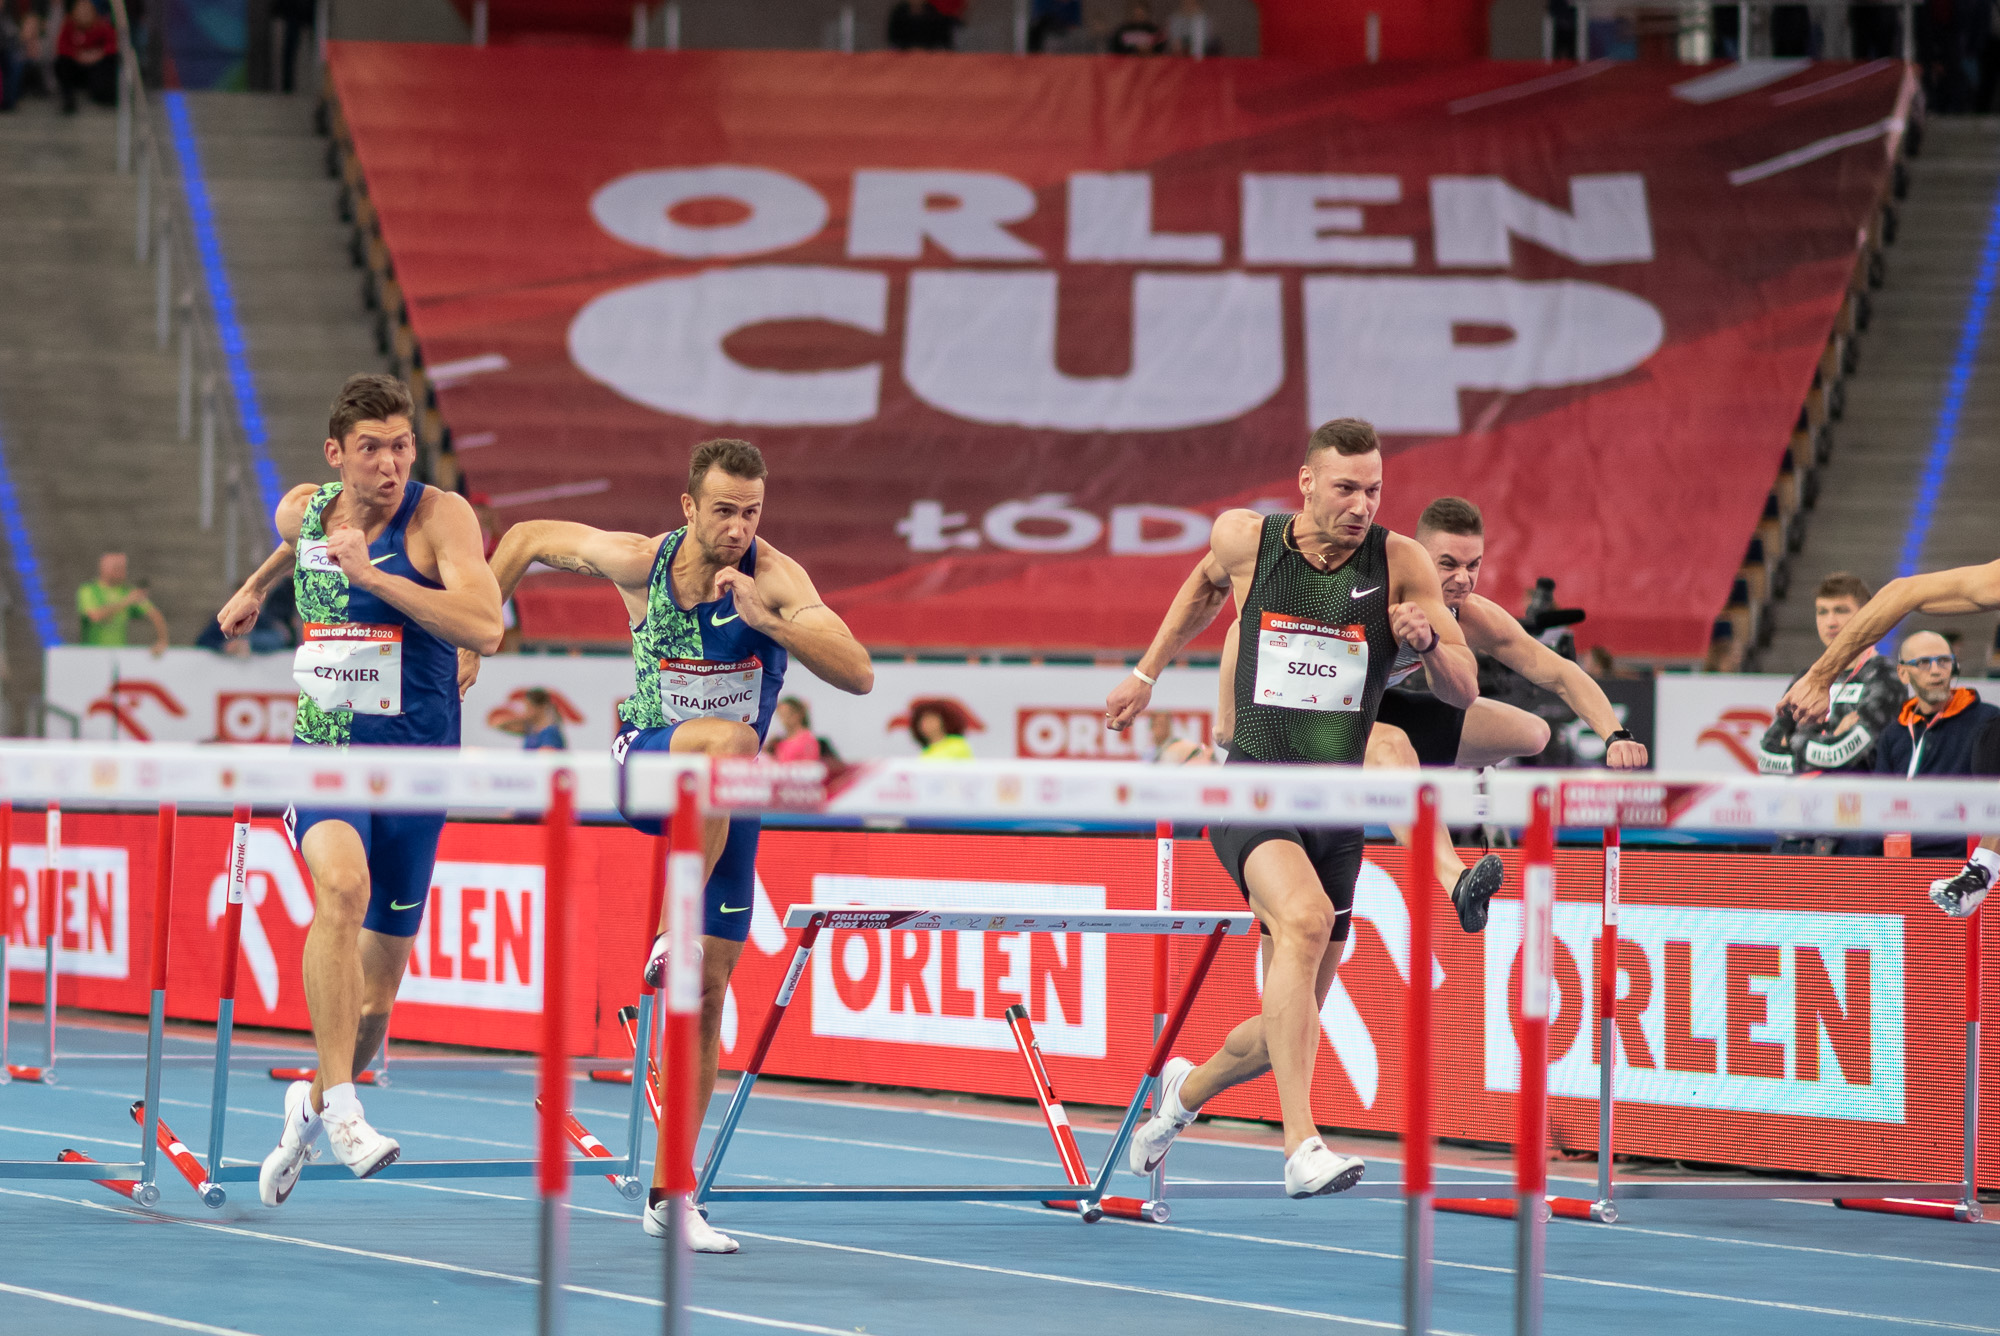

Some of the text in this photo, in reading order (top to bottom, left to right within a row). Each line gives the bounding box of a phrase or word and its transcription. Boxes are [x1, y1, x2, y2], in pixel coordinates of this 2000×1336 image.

[589, 166, 1655, 267] ORLEN
[567, 264, 1663, 435] CUP
[896, 492, 1292, 557] ŁÓD
[309, 627, 393, 638] ORLEN CUP ŁÓDŹ 2020
[1270, 620, 1299, 630] ORLEN
[1299, 623, 1316, 631] CUP
[1317, 625, 1340, 636] ŁÓDŹ
[313, 666, 380, 682] CZYKIER
[668, 663, 697, 672] ORLEN
[713, 663, 736, 671] ŁÓDŹ
[737, 661, 756, 669] 2020
[1287, 661, 1337, 678] SZUCS
[670, 689, 753, 711] TRAJKOVIC
[234, 842, 246, 883] polanik
[1162, 858, 1171, 897] polanik
[1609, 866, 1618, 905] polanik
[8, 868, 114, 954] RLEN
[828, 920, 887, 929] ŁÓDŹ 2020
[831, 913, 891, 921] ORLEN CUP
[408, 886, 532, 986] LEN
[831, 903, 1083, 1027] ORLEN
[1507, 932, 1871, 1086] ORLEN
